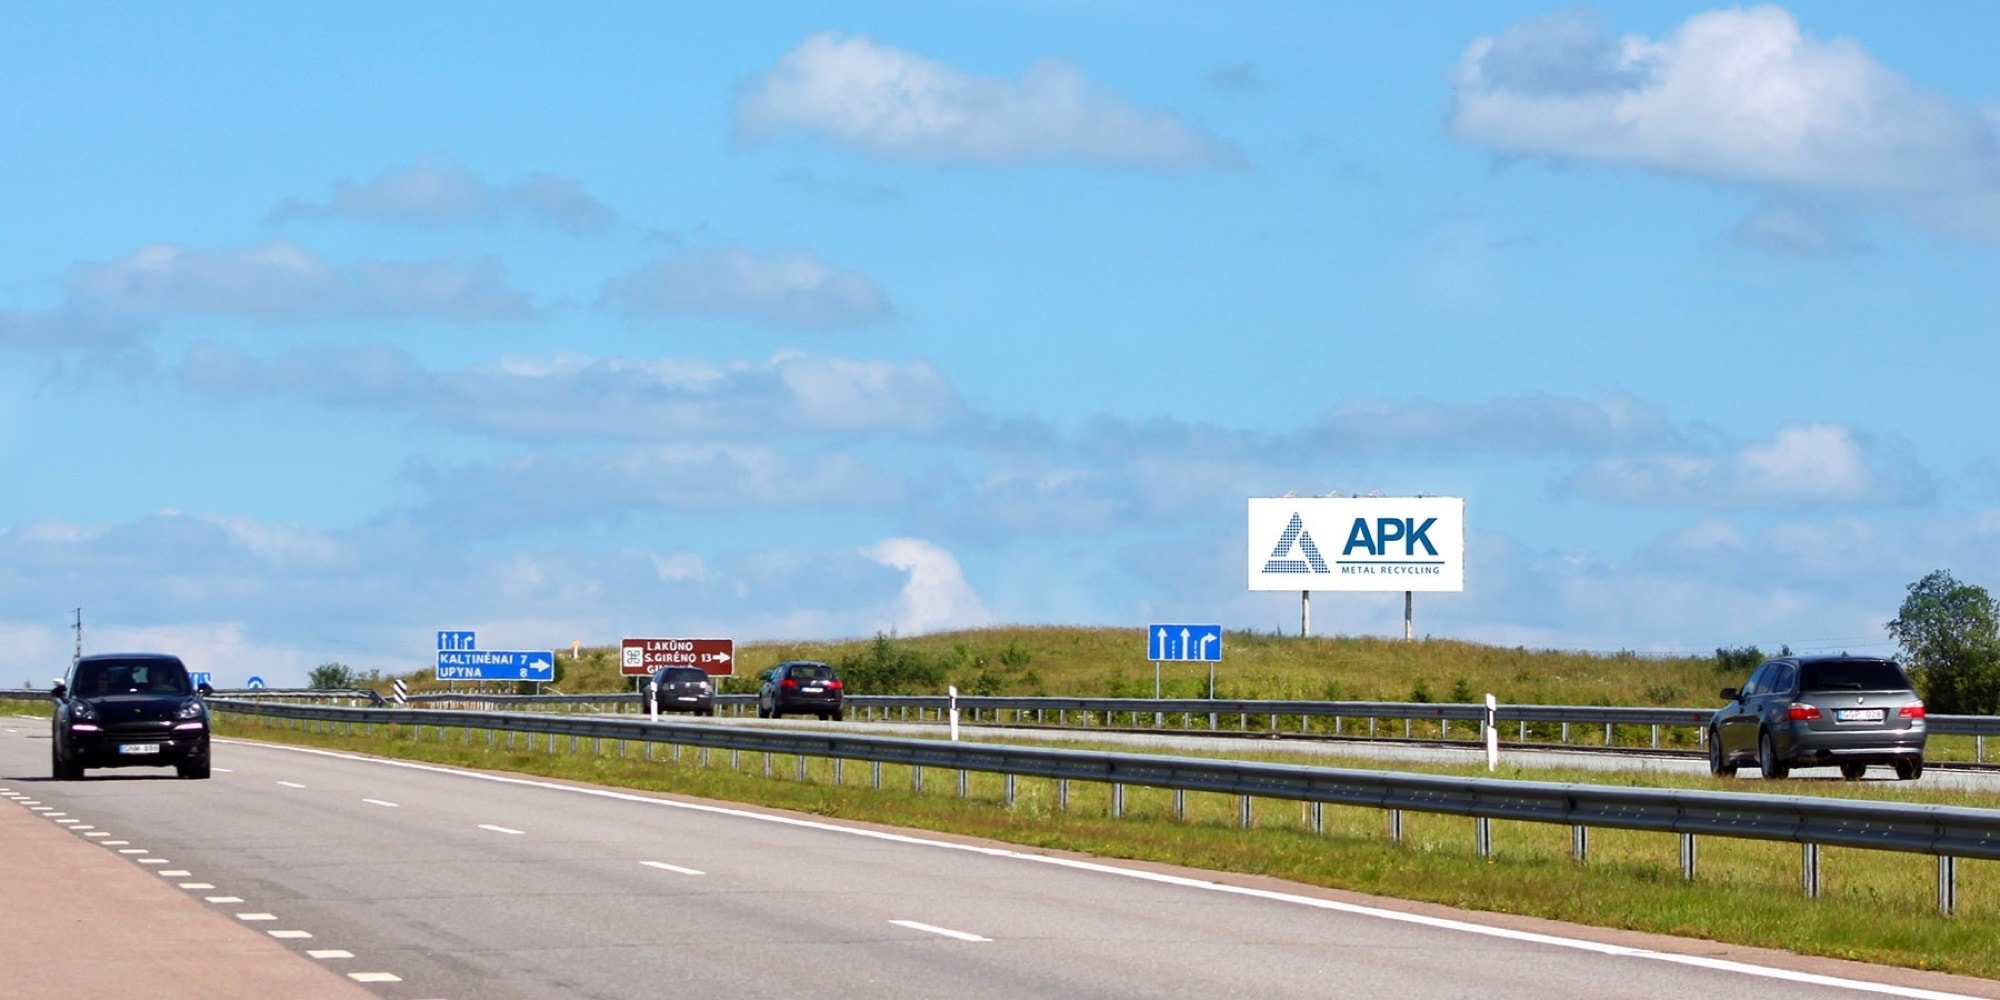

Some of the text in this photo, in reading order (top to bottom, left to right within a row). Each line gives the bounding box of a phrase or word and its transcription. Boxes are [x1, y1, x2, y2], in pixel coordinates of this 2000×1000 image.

[1342, 517, 1439, 556] APK
[1341, 566, 1440, 575] METAL RECYCLING
[520, 655, 528, 665] 7
[701, 653, 712, 662] 13
[440, 667, 528, 678] UPYNA 8
